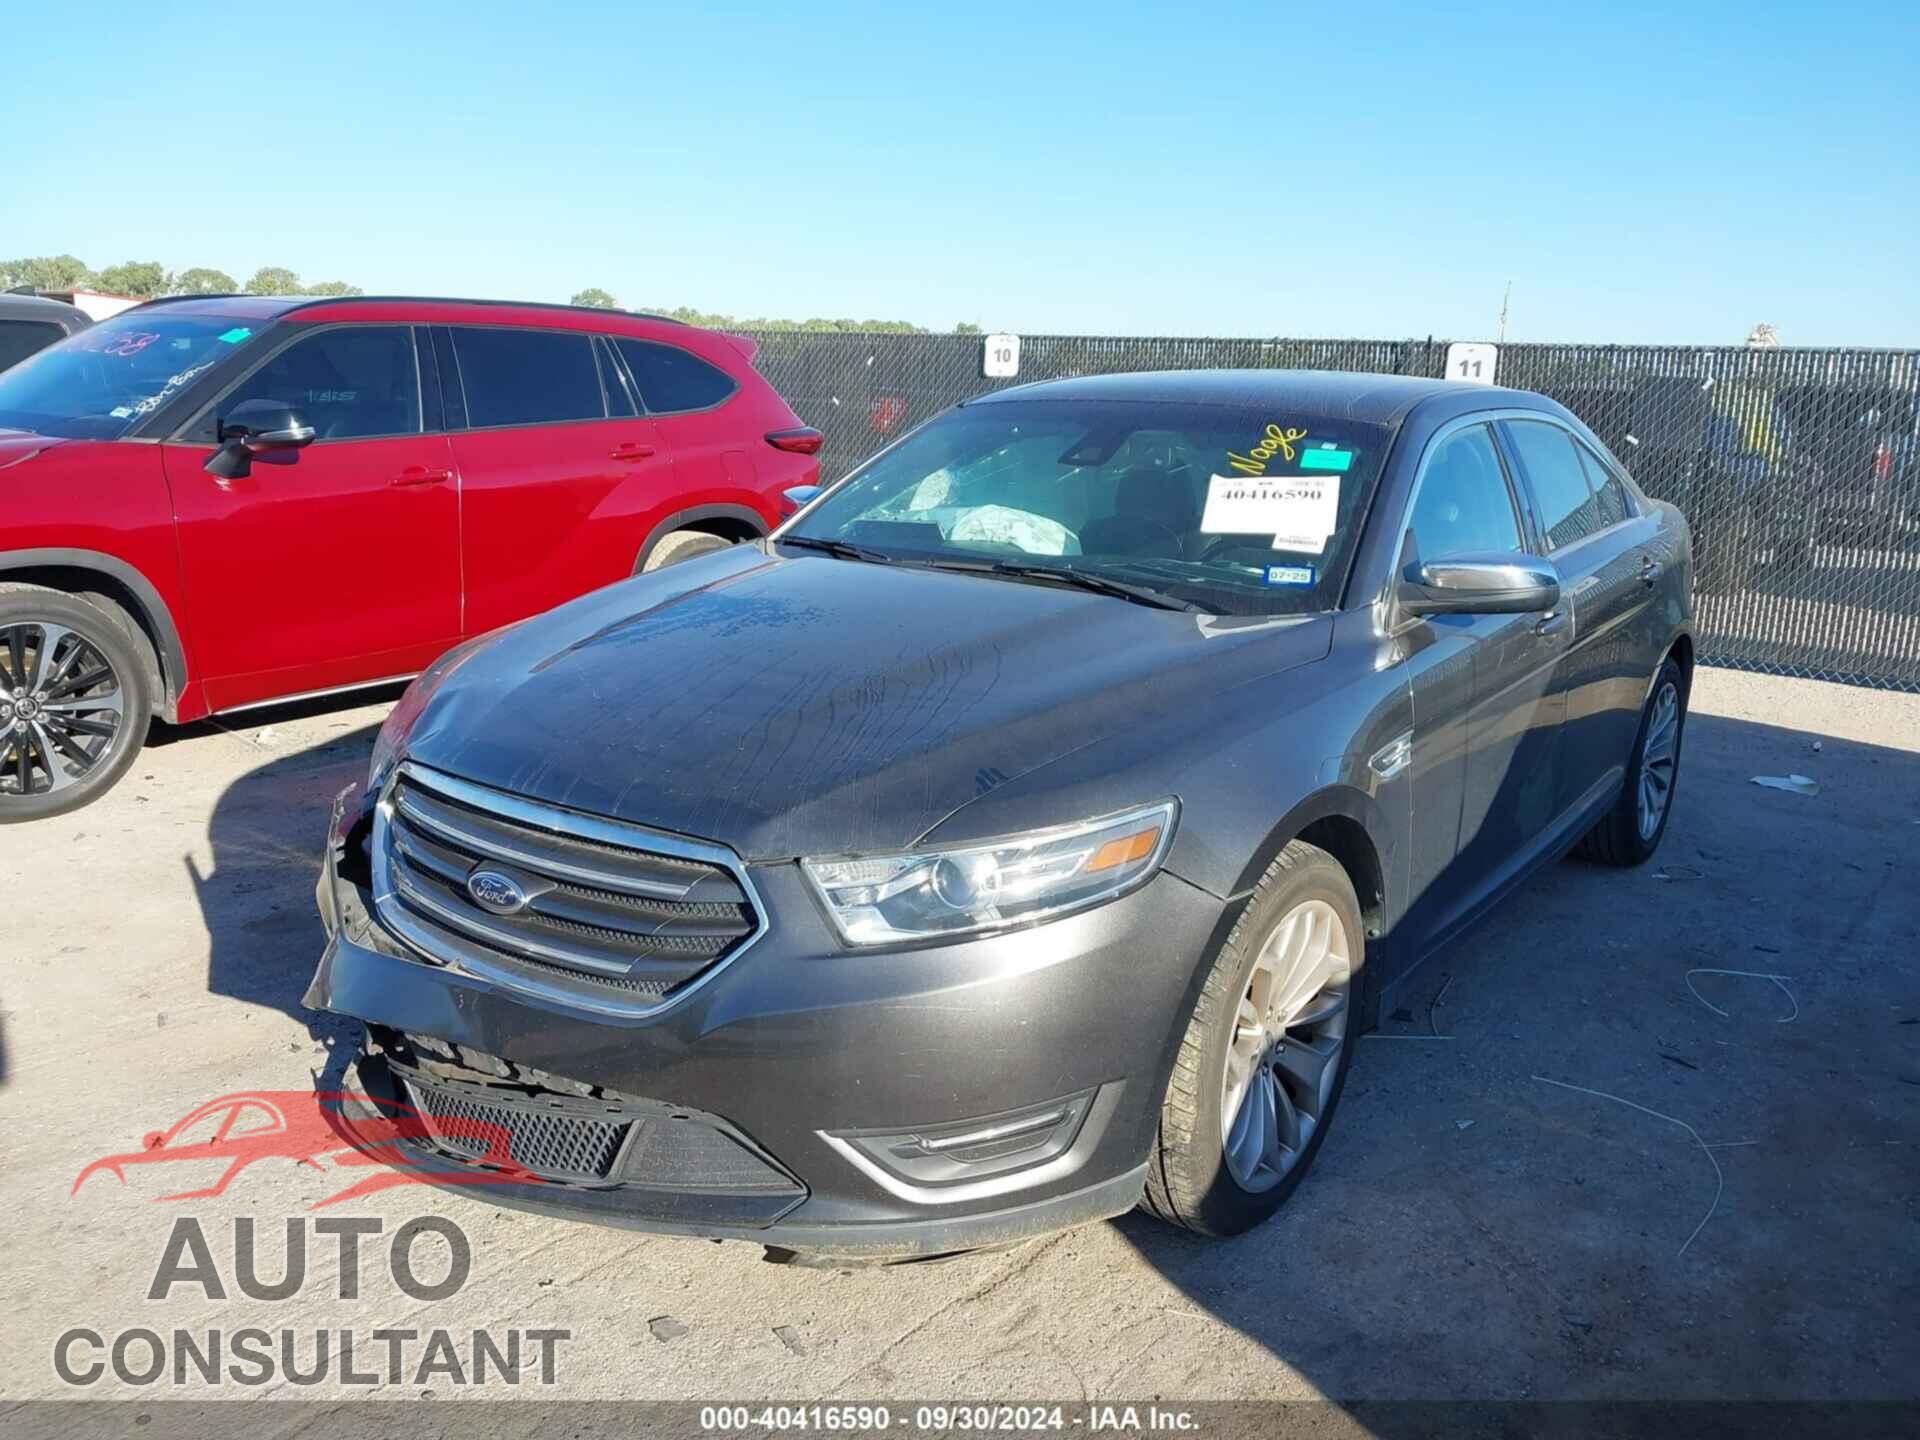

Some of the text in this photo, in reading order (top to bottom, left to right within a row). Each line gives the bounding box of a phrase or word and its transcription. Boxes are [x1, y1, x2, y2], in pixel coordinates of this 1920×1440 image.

[993, 347, 1012, 363] 10
[1459, 359, 1482, 378] 11
[1219, 488, 1322, 501] 40416590
[475, 877, 516, 905] Ford
